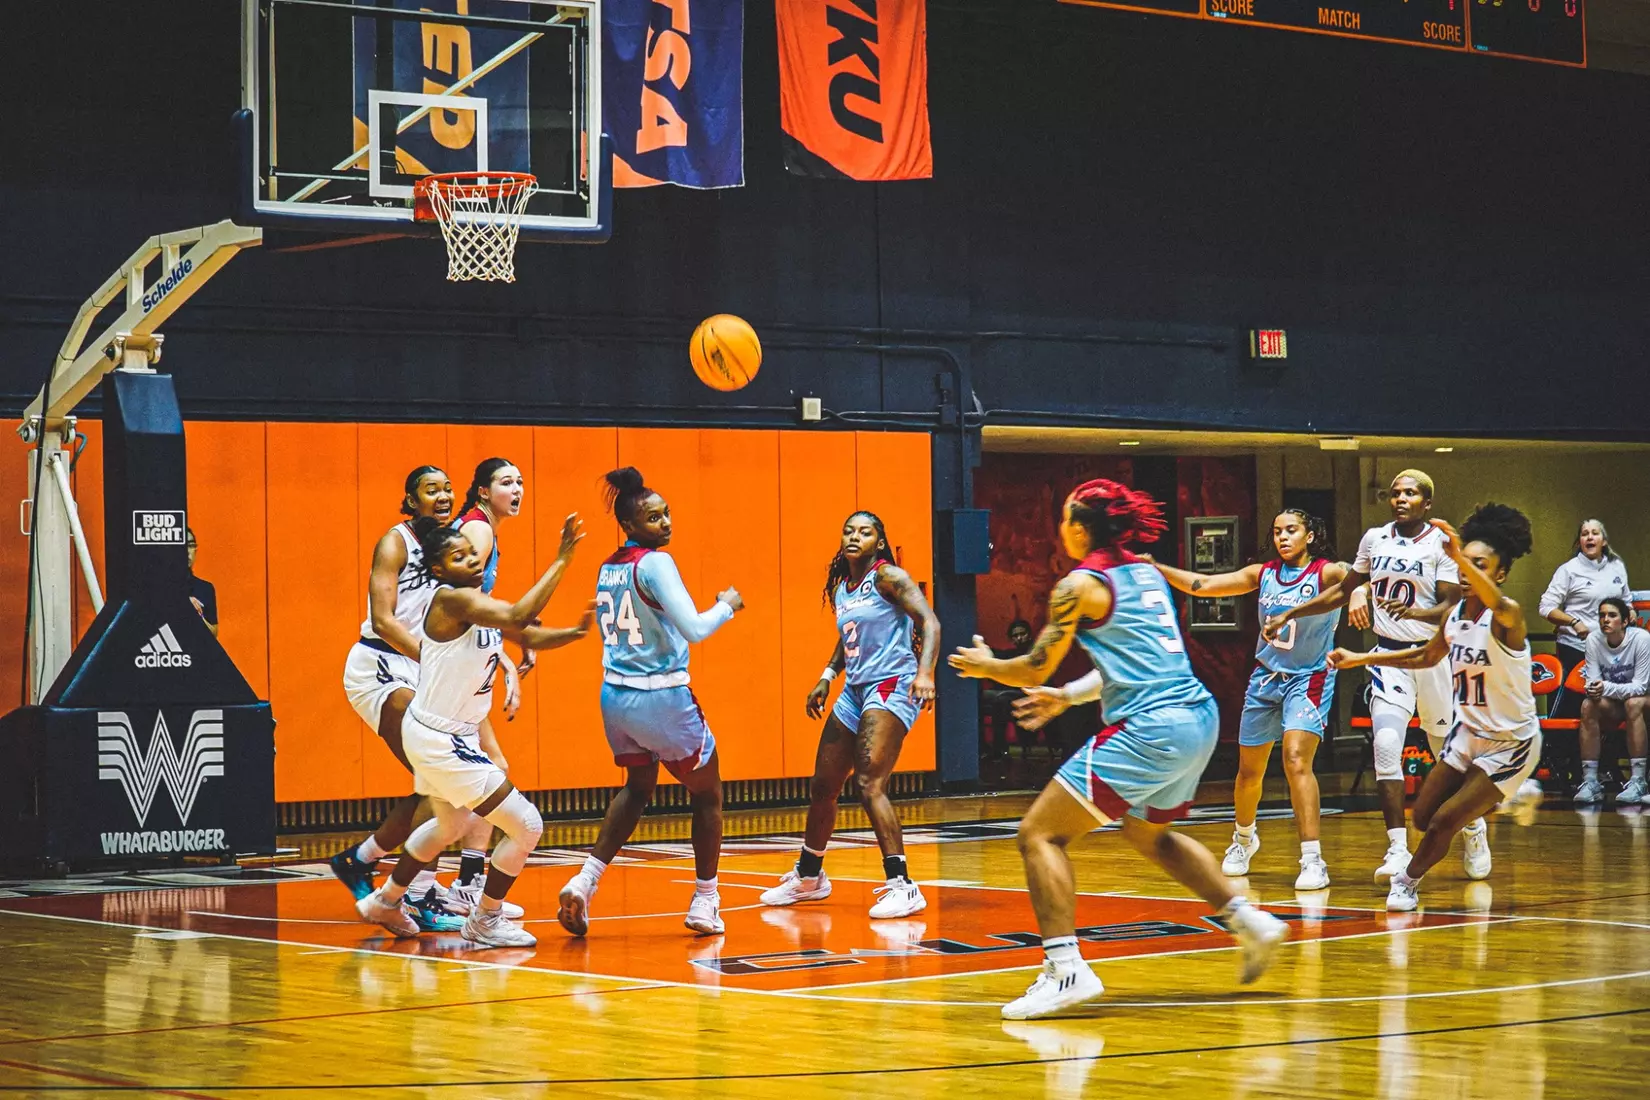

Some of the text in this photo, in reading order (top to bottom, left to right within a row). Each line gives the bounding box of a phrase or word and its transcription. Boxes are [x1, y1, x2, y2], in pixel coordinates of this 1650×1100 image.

[1317, 8, 1361, 30] MATCH
[1423, 21, 1462, 42] SCORE
[142, 258, 193, 314] Schelde
[136, 527, 182, 542] LIGHT
[142, 514, 176, 528] BUD
[1371, 556, 1424, 577] UTSA
[1371, 576, 1416, 609] 10
[596, 589, 645, 646] 24
[1140, 589, 1184, 653] 3
[842, 619, 860, 659] 2
[134, 651, 192, 668] adidas
[473, 652, 499, 696] 2
[1453, 668, 1488, 707] 11
[100, 829, 226, 855] WHATABURGER
